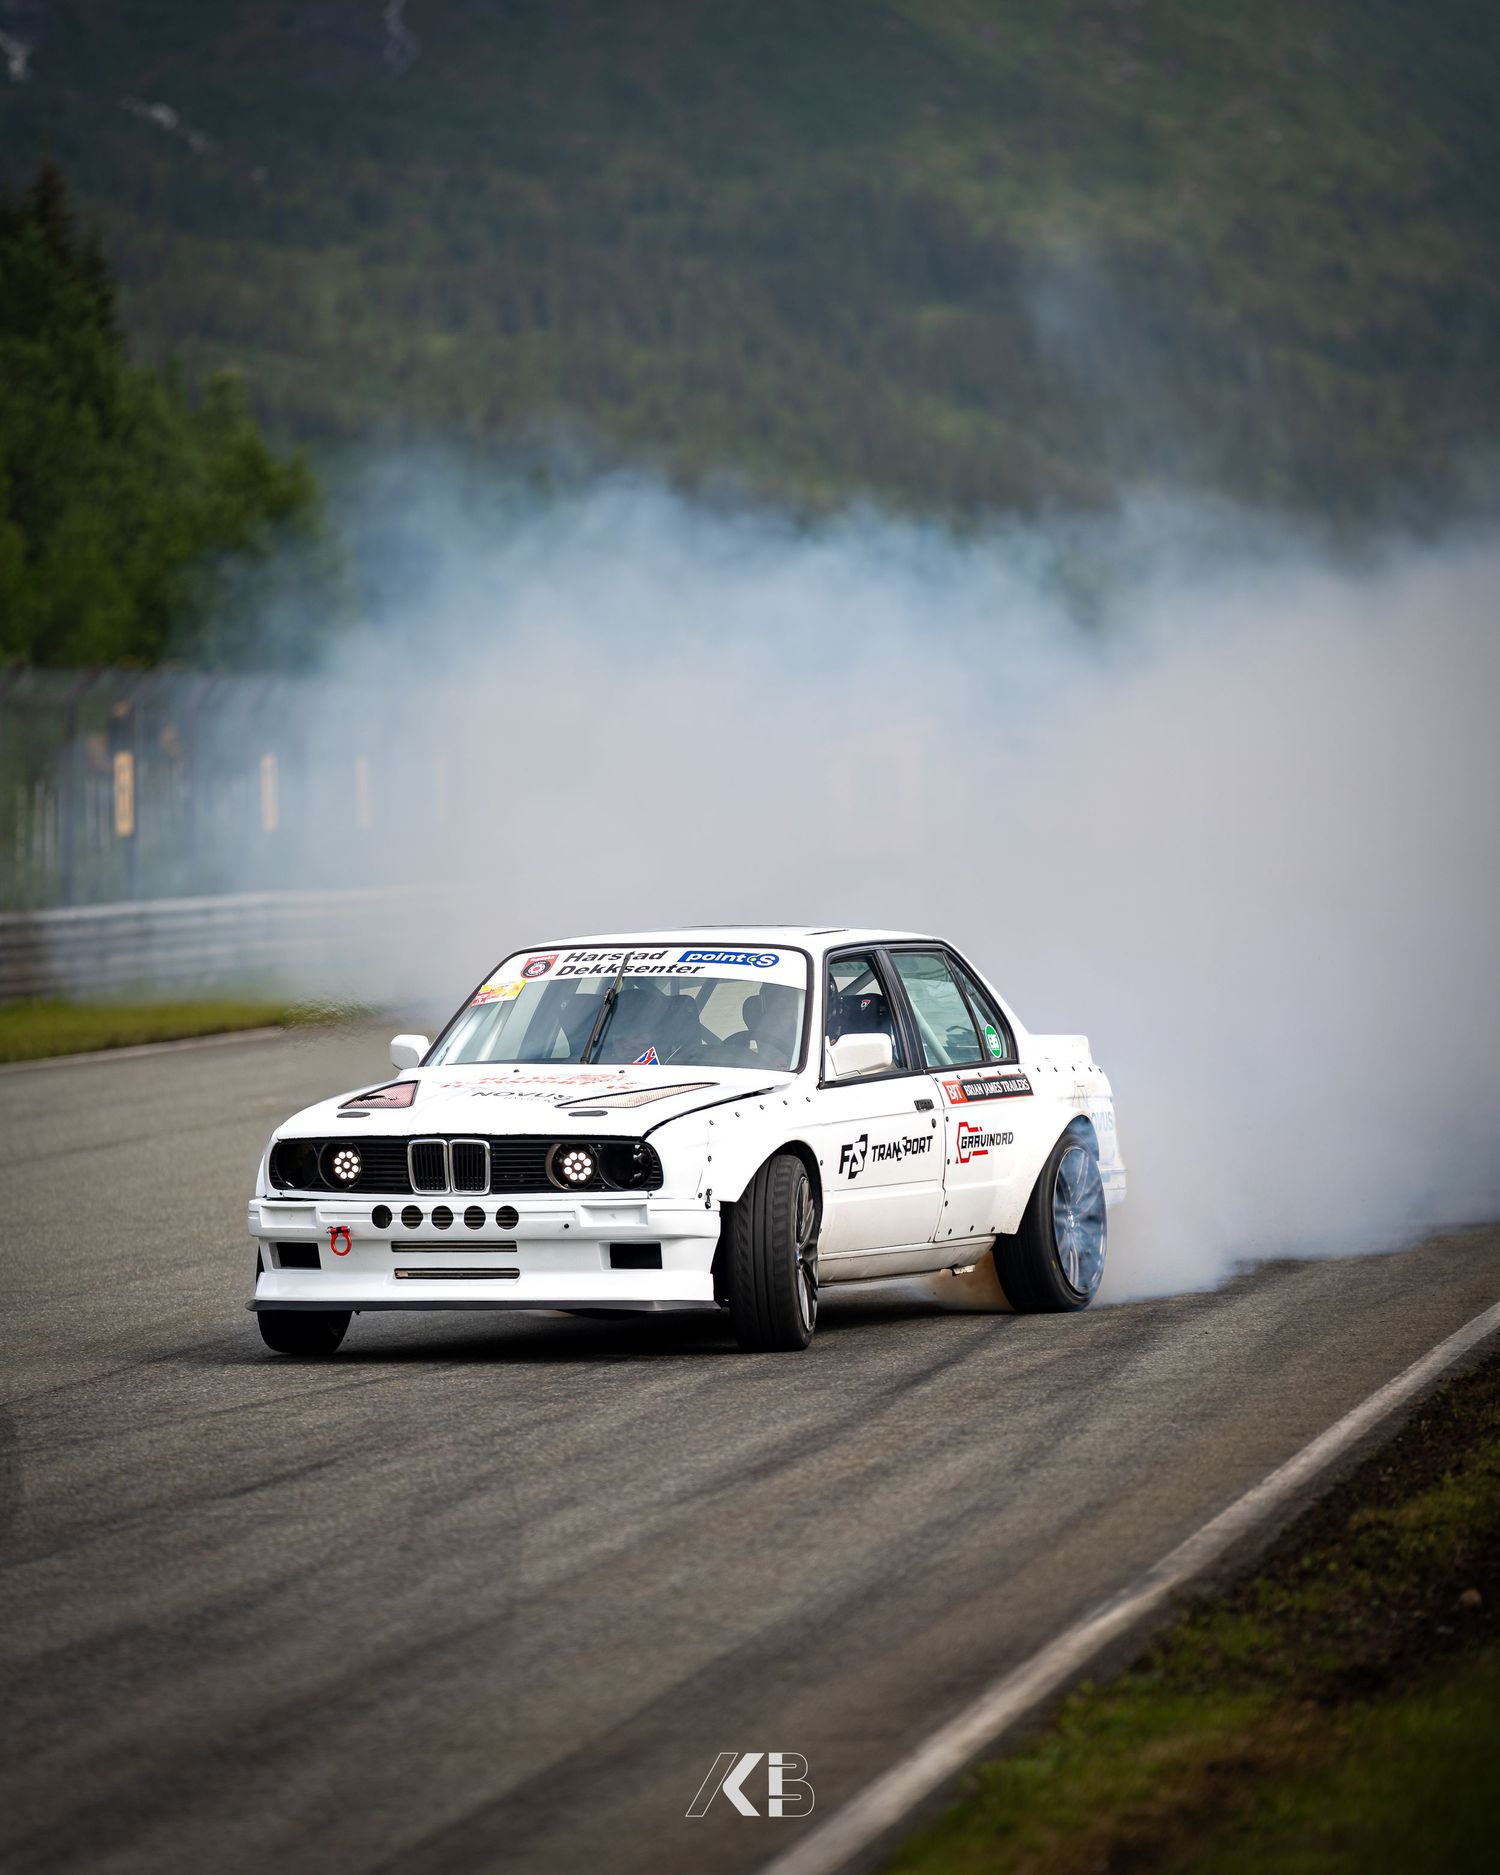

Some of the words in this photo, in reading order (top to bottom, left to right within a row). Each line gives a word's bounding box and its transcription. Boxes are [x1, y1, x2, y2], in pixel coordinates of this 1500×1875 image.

[563, 950, 669, 963] Harstad
[685, 952, 746, 963] point
[756, 955, 776, 967] S
[555, 963, 706, 976] Dekksenter
[945, 1084, 963, 1101] BJT
[963, 1083, 985, 1096] BRIAN
[982, 1080, 1002, 1096] JAMES
[1001, 1079, 1031, 1092] TRAILERS
[871, 1135, 933, 1162] TRANSPORT
